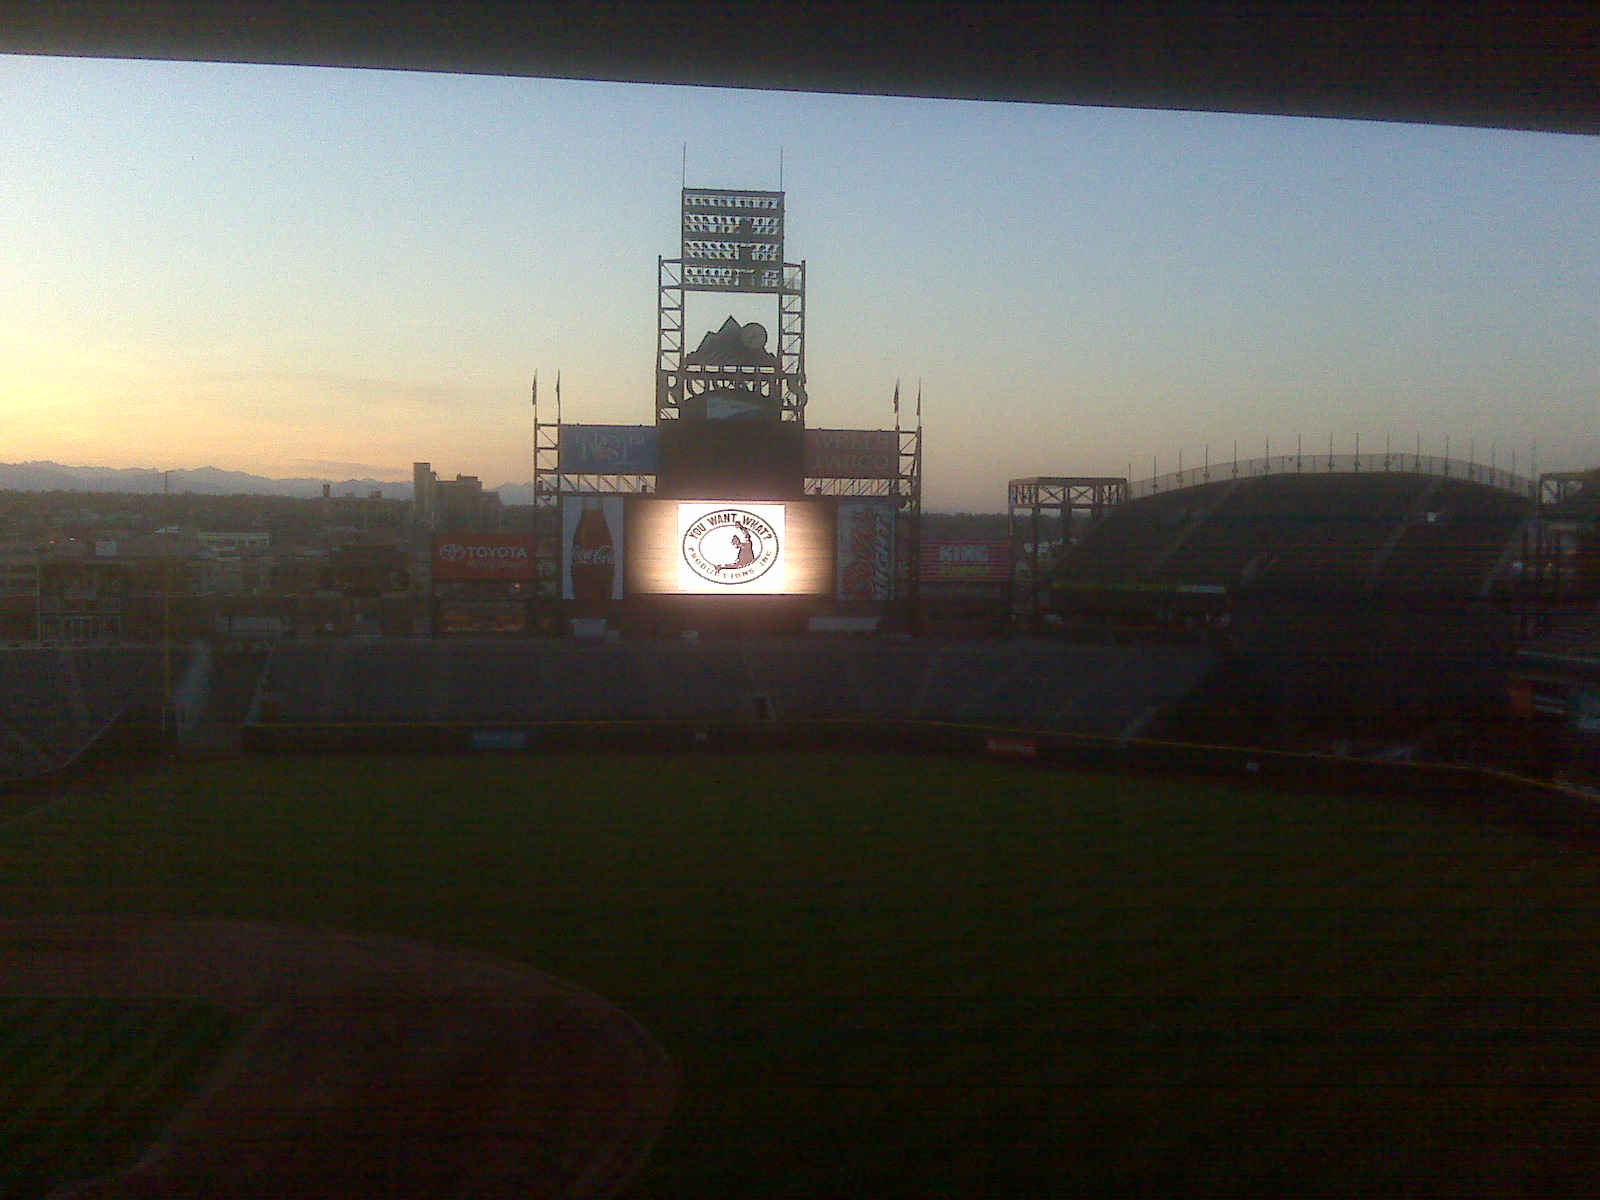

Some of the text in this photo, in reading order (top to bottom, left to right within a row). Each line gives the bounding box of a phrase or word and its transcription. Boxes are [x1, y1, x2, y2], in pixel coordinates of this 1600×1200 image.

[689, 513, 772, 540] YOU WANT WHAT?
[466, 546, 527, 558] TOYOTA
